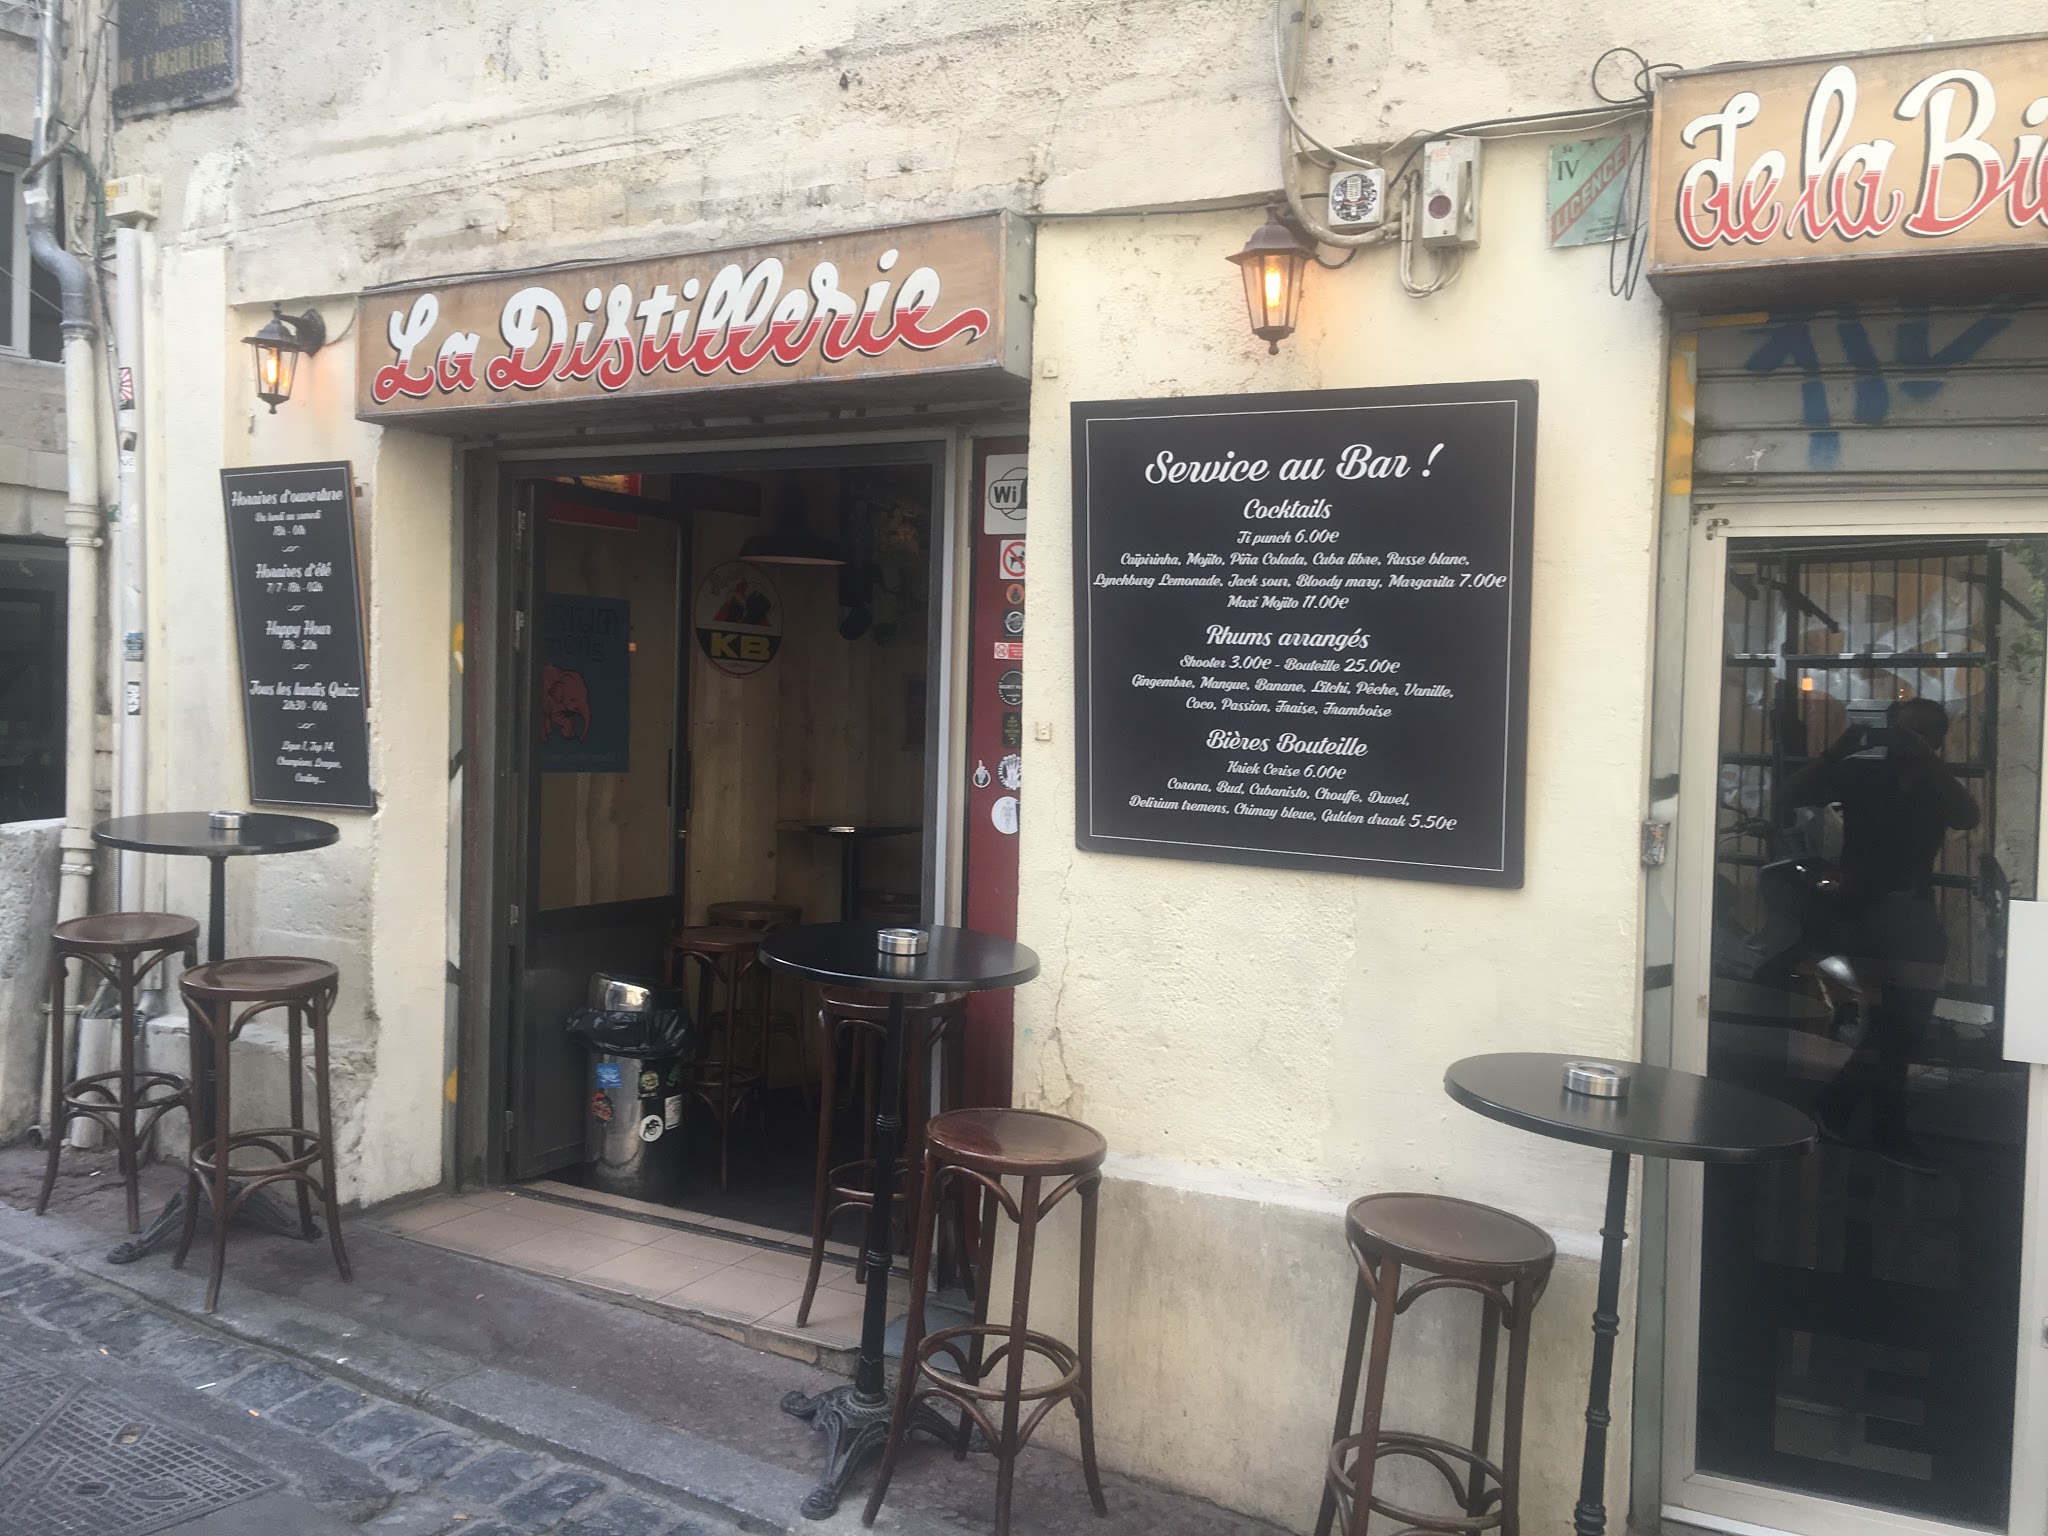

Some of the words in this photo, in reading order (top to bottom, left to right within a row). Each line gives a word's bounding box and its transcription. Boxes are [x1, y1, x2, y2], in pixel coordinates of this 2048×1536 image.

[1680, 91, 1786, 248] de
[1787, 65, 1904, 240] la
[1896, 69, 2048, 236] Bi
[1558, 160, 1580, 180] IV
[1556, 147, 1624, 235] LICENCE
[372, 292, 480, 403] La
[487, 248, 991, 390] Distillerie
[1145, 450, 1270, 484] Service
[1279, 455, 1325, 481] au
[1336, 444, 1410, 480] Bar
[1421, 443, 1444, 477] !
[231, 491, 278, 506] Horaires
[280, 488, 344, 504] d'ouverture
[994, 486, 1017, 504] Wi
[1243, 498, 1333, 520] Cocktails
[1236, 531, 1252, 544] Ti
[1251, 531, 1292, 546] punch
[1294, 529, 1340, 544] 6.00€
[1229, 552, 1259, 565] Piña
[1262, 552, 1308, 566] Colada,
[1312, 552, 1346, 565] Cuba
[1347, 552, 1382, 566] libre,
[1386, 552, 1426, 565] Russe
[1428, 552, 1470, 566] blanc,
[255, 563, 302, 579] Horaires
[304, 562, 333, 577] d'été
[1093, 573, 1156, 588] Lynchburg
[1158, 573, 1224, 587] Lemonade,
[1227, 574, 1258, 587] Jack
[1260, 577, 1291, 588] sour,
[1296, 574, 1343, 590] Bloody
[1344, 577, 1383, 590] mary,
[1388, 574, 1456, 590] Margarita
[1458, 573, 1507, 588] 7.00€
[1227, 595, 1259, 609] Maxi
[1260, 595, 1299, 611] Mojito
[1302, 595, 1350, 610] 11.00€
[265, 620, 301, 638] Happy
[303, 620, 332, 636] Hour
[1206, 624, 1273, 647] Rhums
[1278, 628, 1371, 651] arrangés
[710, 632, 770, 661] KB
[1179, 655, 1227, 669] Shooter
[1229, 655, 1272, 670] 3.00€
[1284, 658, 1341, 673] Bouteille
[1343, 658, 1401, 674] 25.00€
[249, 680, 275, 696] Tous
[276, 682, 292, 697] les
[293, 682, 326, 697] lundis
[1132, 674, 1196, 689] Gingembre,
[1200, 676, 1251, 692] Mangue,
[1255, 678, 1306, 693] Banane,
[1311, 680, 1351, 695] Litchi,
[1356, 681, 1400, 696] Pêche,
[1404, 683, 1454, 698] Vanille,
[1186, 697, 1217, 711] Coco,
[1221, 698, 1271, 713] Passion,
[1275, 700, 1318, 715] Fraise,
[1323, 702, 1392, 717] Framboise
[1206, 729, 1271, 752] Bières
[1276, 732, 1369, 757] Bouteille
[1227, 760, 1260, 775] Kriek
[1263, 763, 1301, 777] Cerise
[1303, 764, 1347, 780] 6.00€
[1167, 777, 1212, 793] Corona,
[1216, 780, 1245, 795] Bud,
[1249, 782, 1311, 800] Cubanisto,
[1315, 787, 1363, 804] Chouffe,
[1367, 790, 1410, 806] Duvel,
[1129, 794, 1180, 810] Delirium
[1181, 799, 1230, 814] tremens,
[1234, 802, 1279, 820] Chimay
[1280, 806, 1317, 821] bleue,
[1321, 808, 1365, 824] Gulden
[1367, 813, 1407, 827] draak
[1409, 814, 1458, 831] 5.50€
